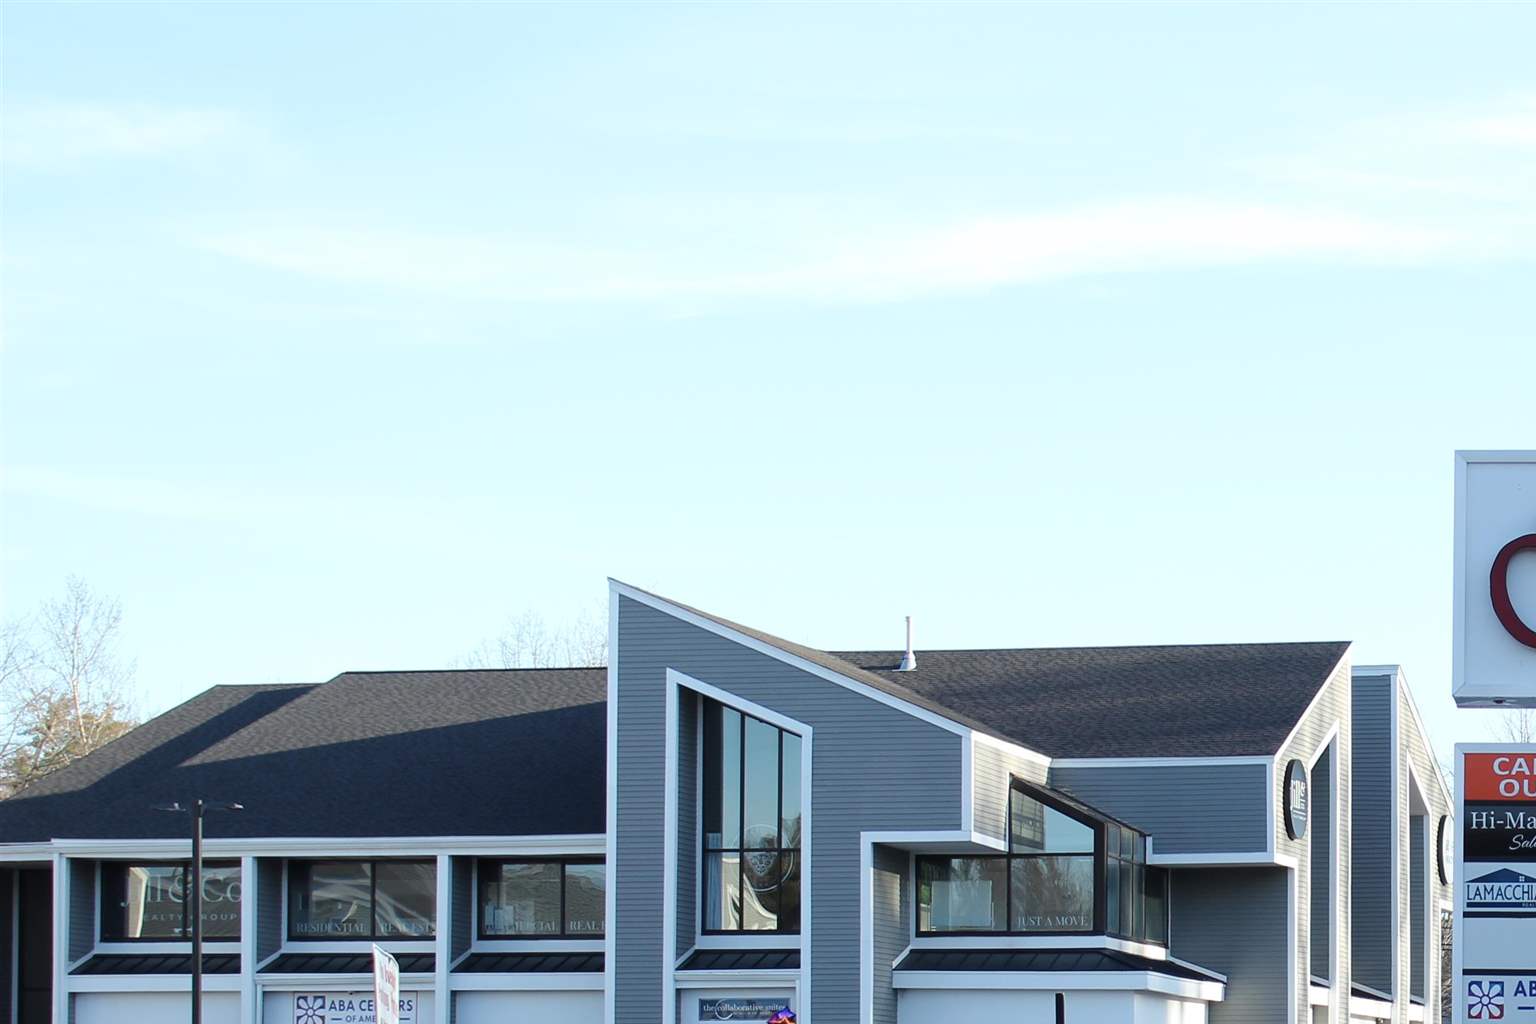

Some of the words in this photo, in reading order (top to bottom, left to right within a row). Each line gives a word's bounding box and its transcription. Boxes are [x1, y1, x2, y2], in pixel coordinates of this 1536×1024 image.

[1017, 915, 1042, 928] JUST
[1055, 915, 1088, 926] MOVE
[328, 999, 355, 1011] ABA
[358, 999, 413, 1011] CERS
[345, 1015, 356, 1023] OF
